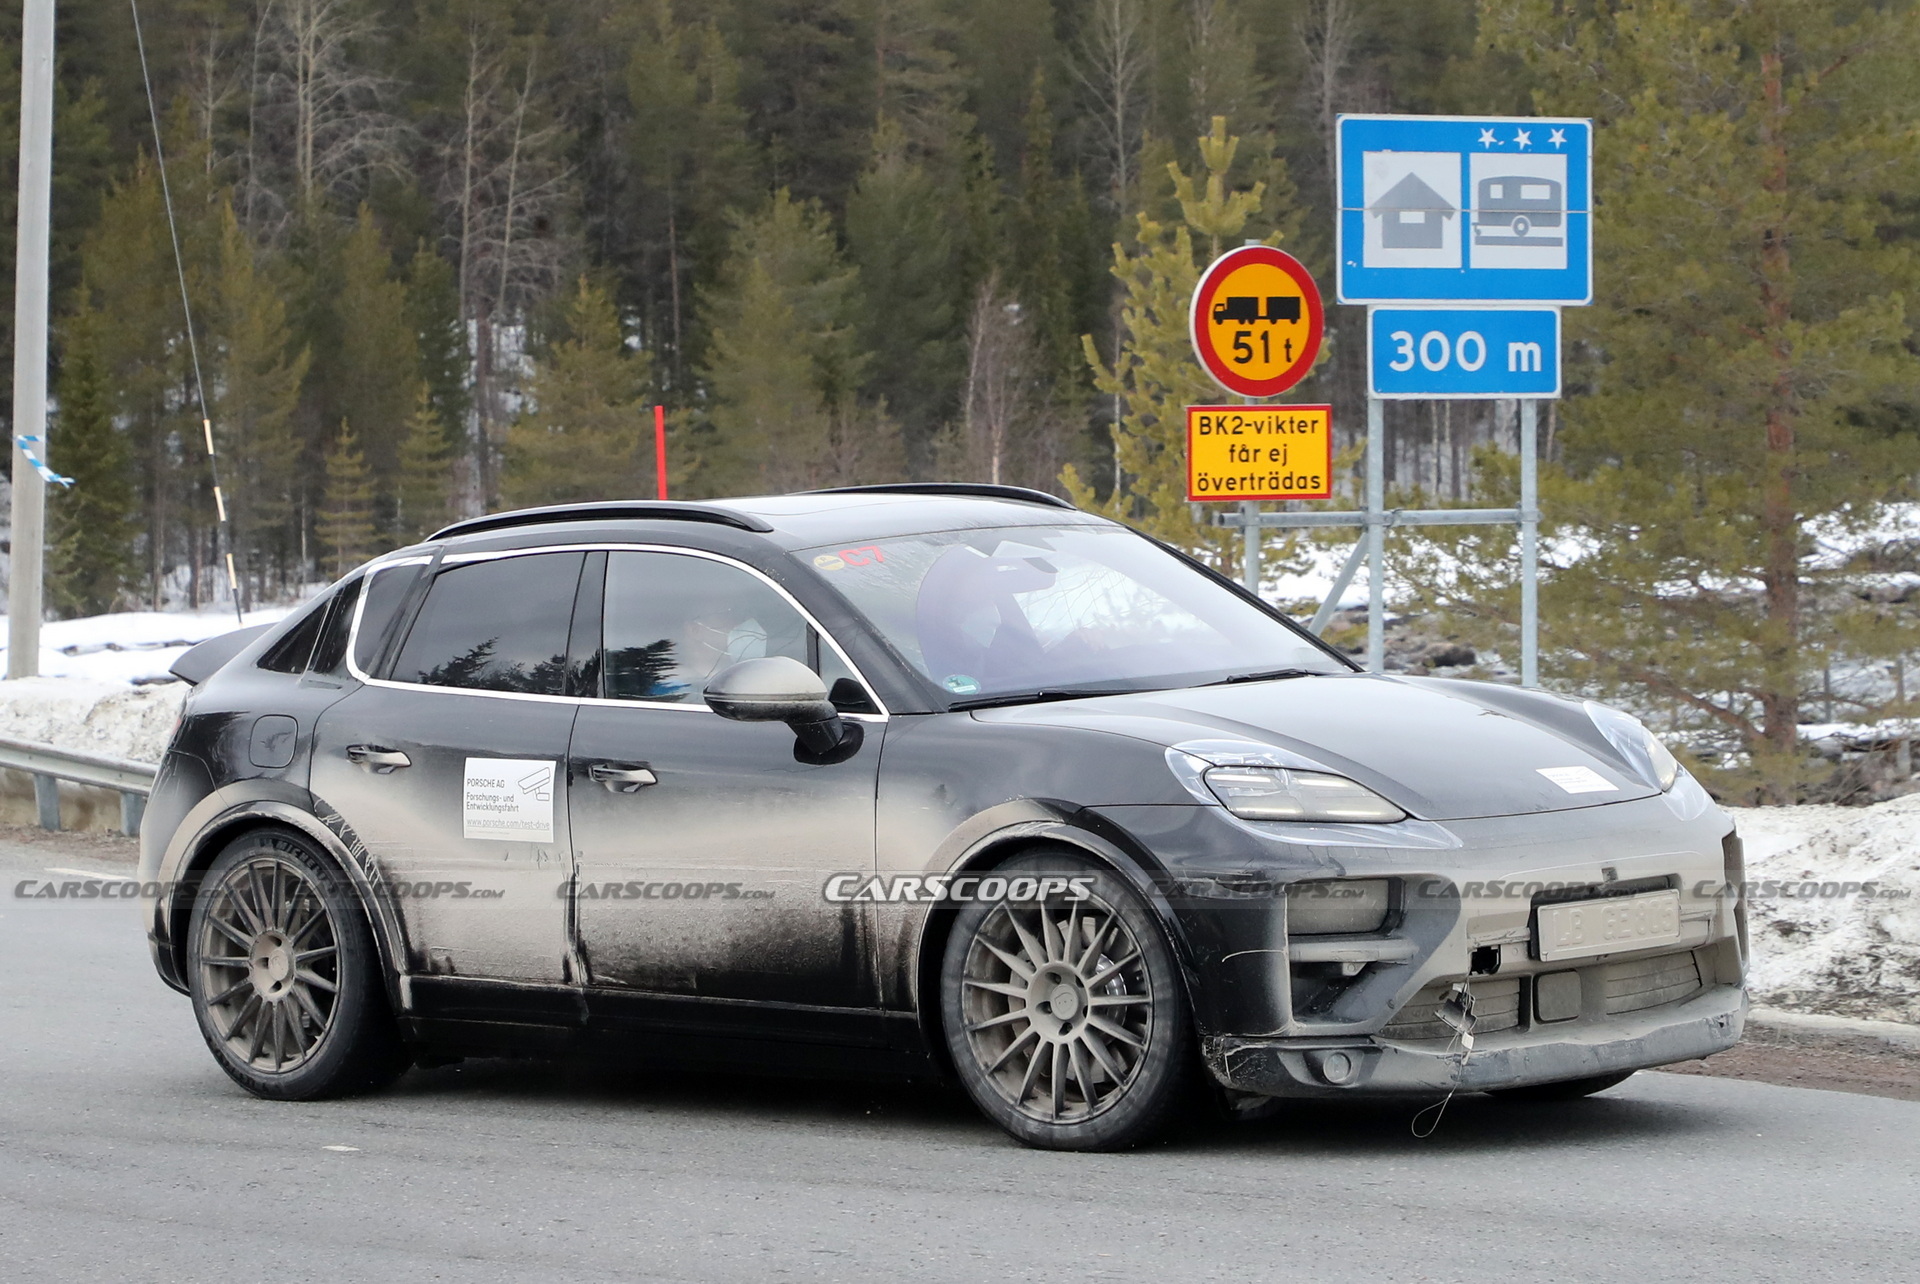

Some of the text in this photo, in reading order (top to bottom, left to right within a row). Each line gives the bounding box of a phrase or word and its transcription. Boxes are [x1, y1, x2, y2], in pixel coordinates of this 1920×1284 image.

[1233, 330, 1292, 364] 51 t
[1389, 330, 1542, 372] 300 m
[1199, 415, 1319, 435] BK2-vikter
[1229, 443, 1288, 467] får ej
[1197, 471, 1321, 491] överträdas
[838, 545, 886, 566] C7
[467, 779, 505, 788] PORSCHE AG
[467, 792, 514, 803] Forschungs- und
[467, 801, 519, 813] Entwicklungsfahrt
